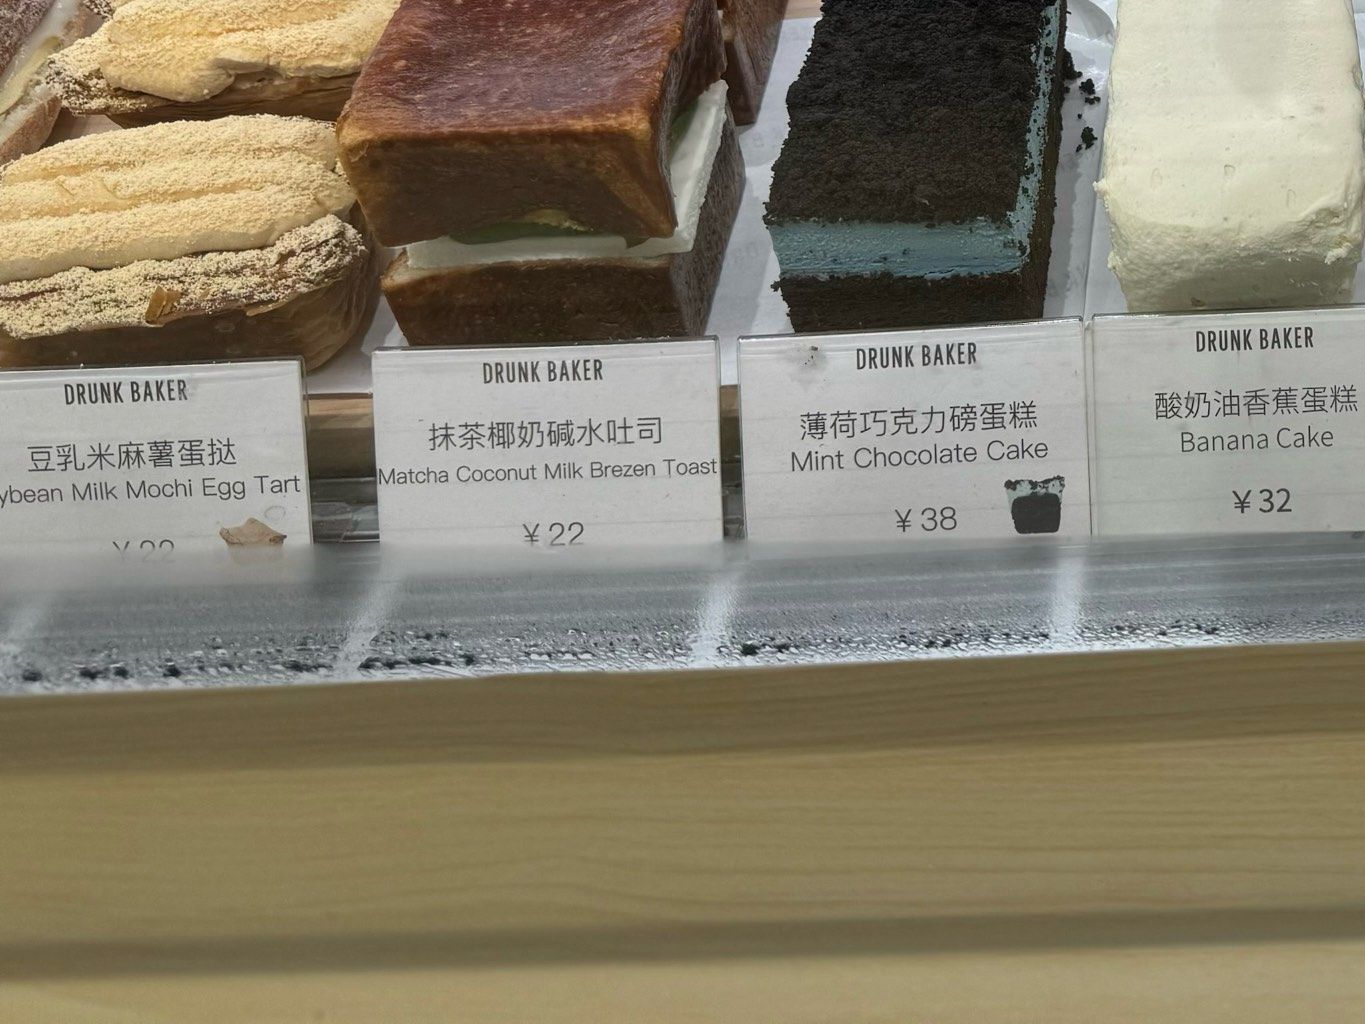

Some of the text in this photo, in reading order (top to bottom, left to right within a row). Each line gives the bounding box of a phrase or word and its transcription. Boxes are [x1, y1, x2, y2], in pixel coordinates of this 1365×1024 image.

[1196, 326, 1314, 352] DRUNK BAKER
[856, 342, 977, 370] DRUNK BAKER
[482, 359, 603, 384] DRUNK BAKER
[64, 379, 188, 405] DRUNK BAKER
[1155, 384, 1358, 420] 酸奶油香蕉蛋糕
[428, 416, 662, 451] 抹茶椰奶碱水吐司
[800, 400, 1037, 441] 薄荷巧克力磅蛋糕
[1180, 426, 1334, 453] Banana Cake
[27, 437, 237, 472] 豆乳米麻薯蛋挞
[791, 439, 1049, 472] Mint Chocolate Cake
[378, 457, 718, 485] Matcha Coconut Milk Brezen Toast
[72, 481, 118, 502] Milk
[126, 478, 193, 499] Mochi
[202, 477, 246, 501] Egg
[253, 474, 301, 494] Tart
